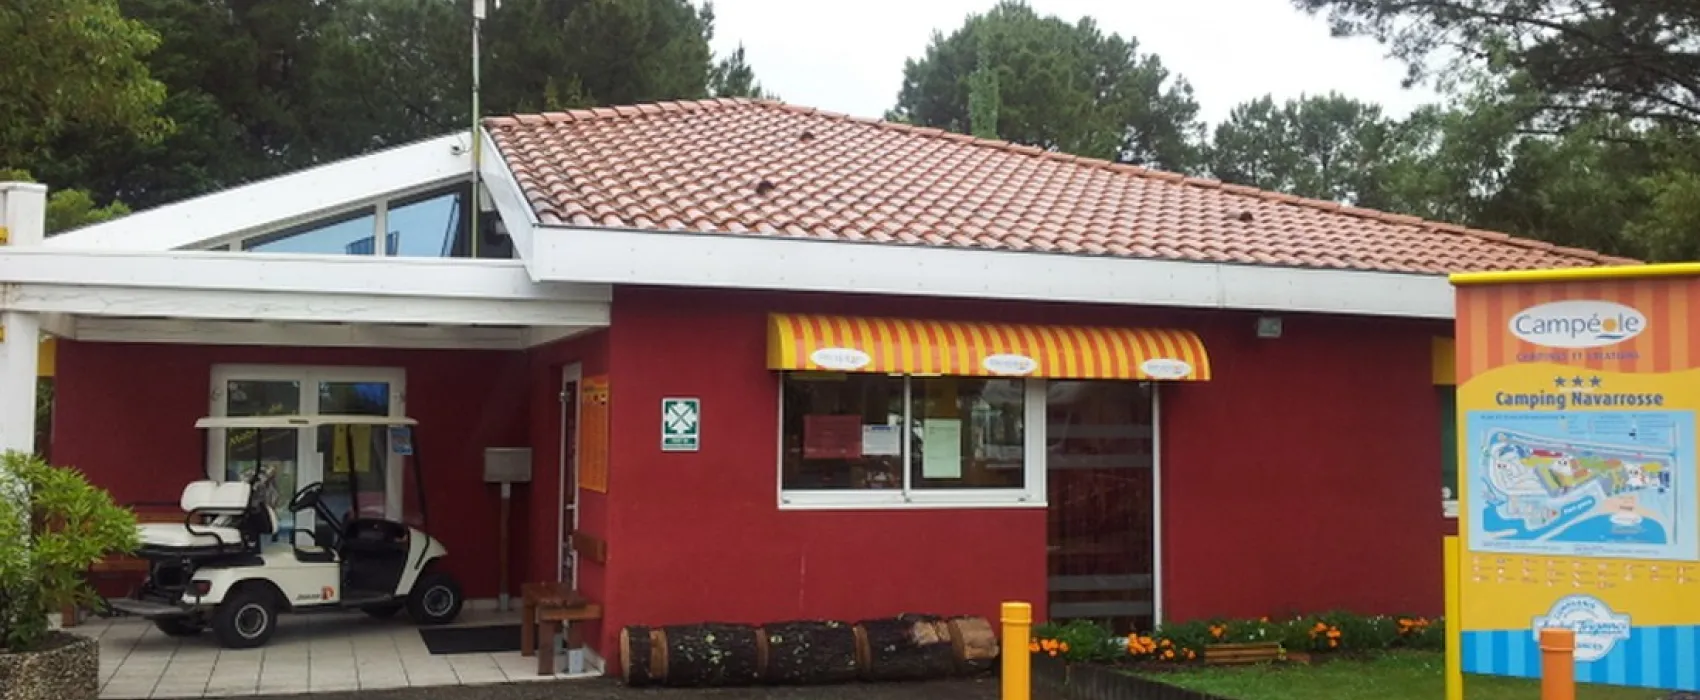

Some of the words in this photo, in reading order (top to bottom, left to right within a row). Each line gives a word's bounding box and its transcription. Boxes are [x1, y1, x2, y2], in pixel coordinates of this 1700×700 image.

[1515, 312, 1639, 338] Campéole
[1495, 390, 1566, 410] Camping
[1572, 390, 1664, 407] Navarrosse
